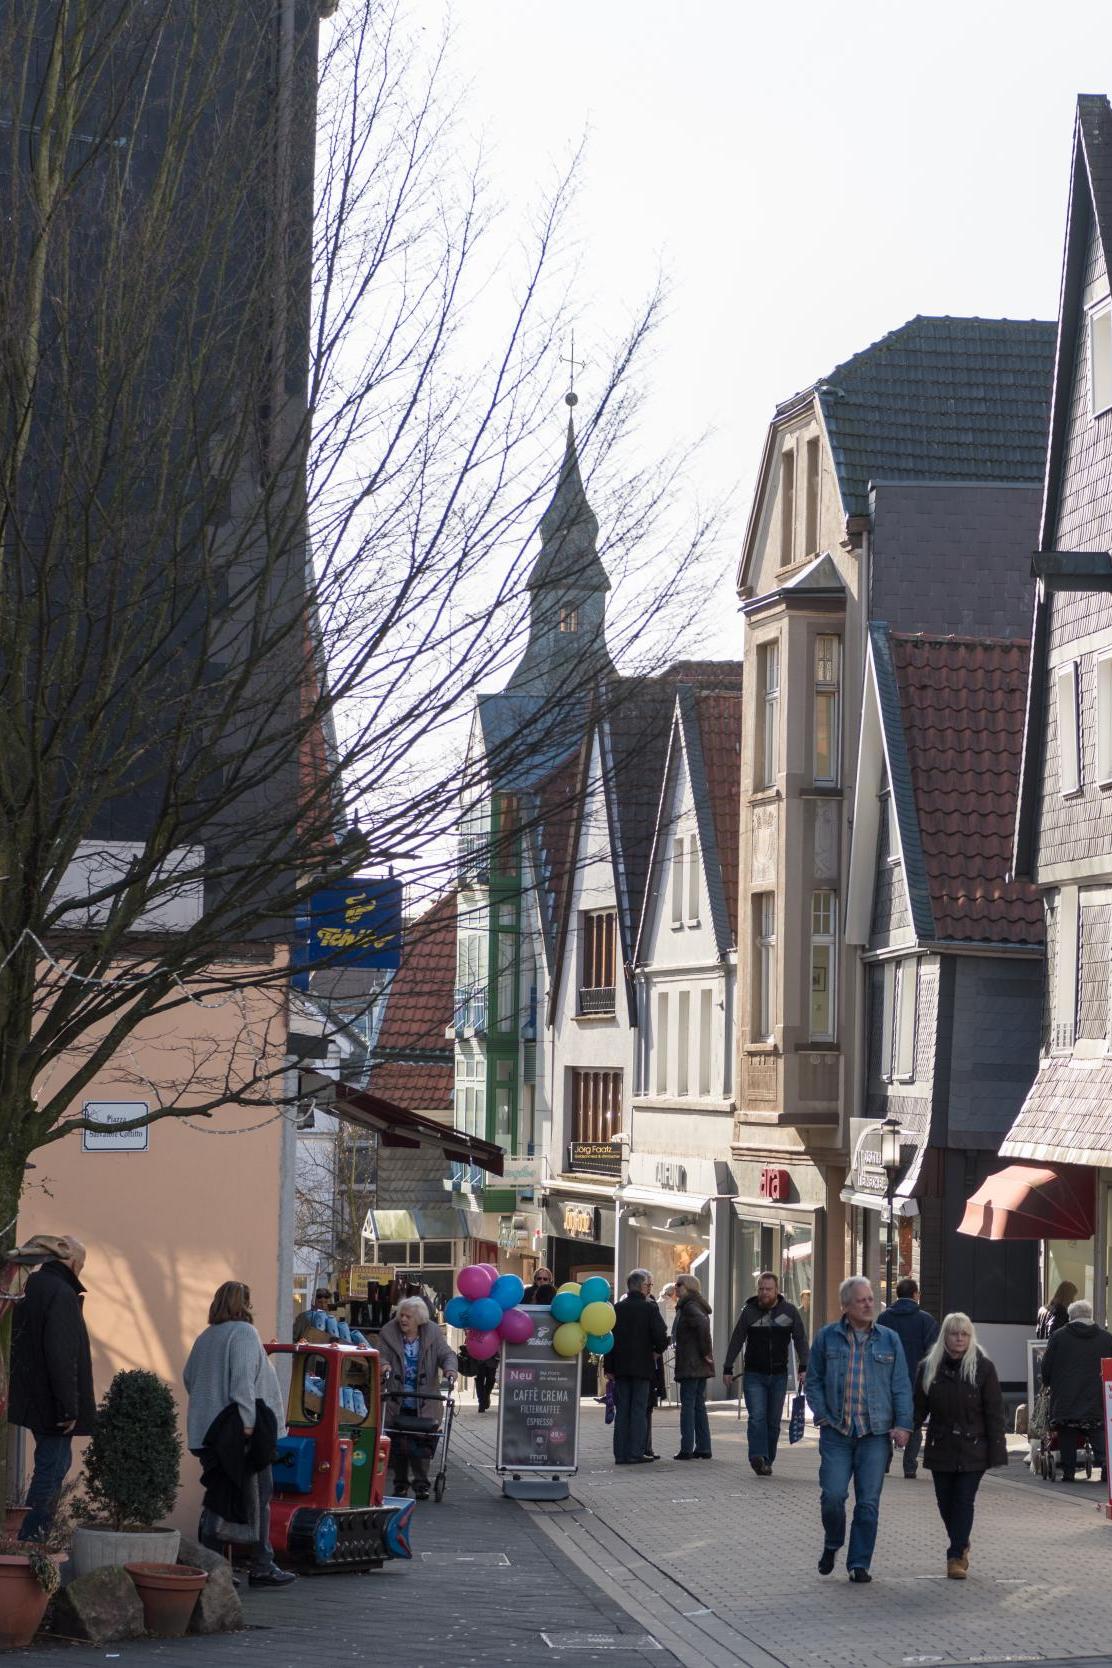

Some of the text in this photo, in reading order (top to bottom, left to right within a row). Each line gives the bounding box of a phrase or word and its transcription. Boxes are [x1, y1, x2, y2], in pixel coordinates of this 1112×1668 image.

[760, 1168, 783, 1201] ara
[511, 1370, 533, 1380] Neu
[541, 1390, 568, 1402] CREMA
[520, 1405, 561, 1414] FILTERKAFFEE
[527, 1418, 553, 1426] ESPRESSO
